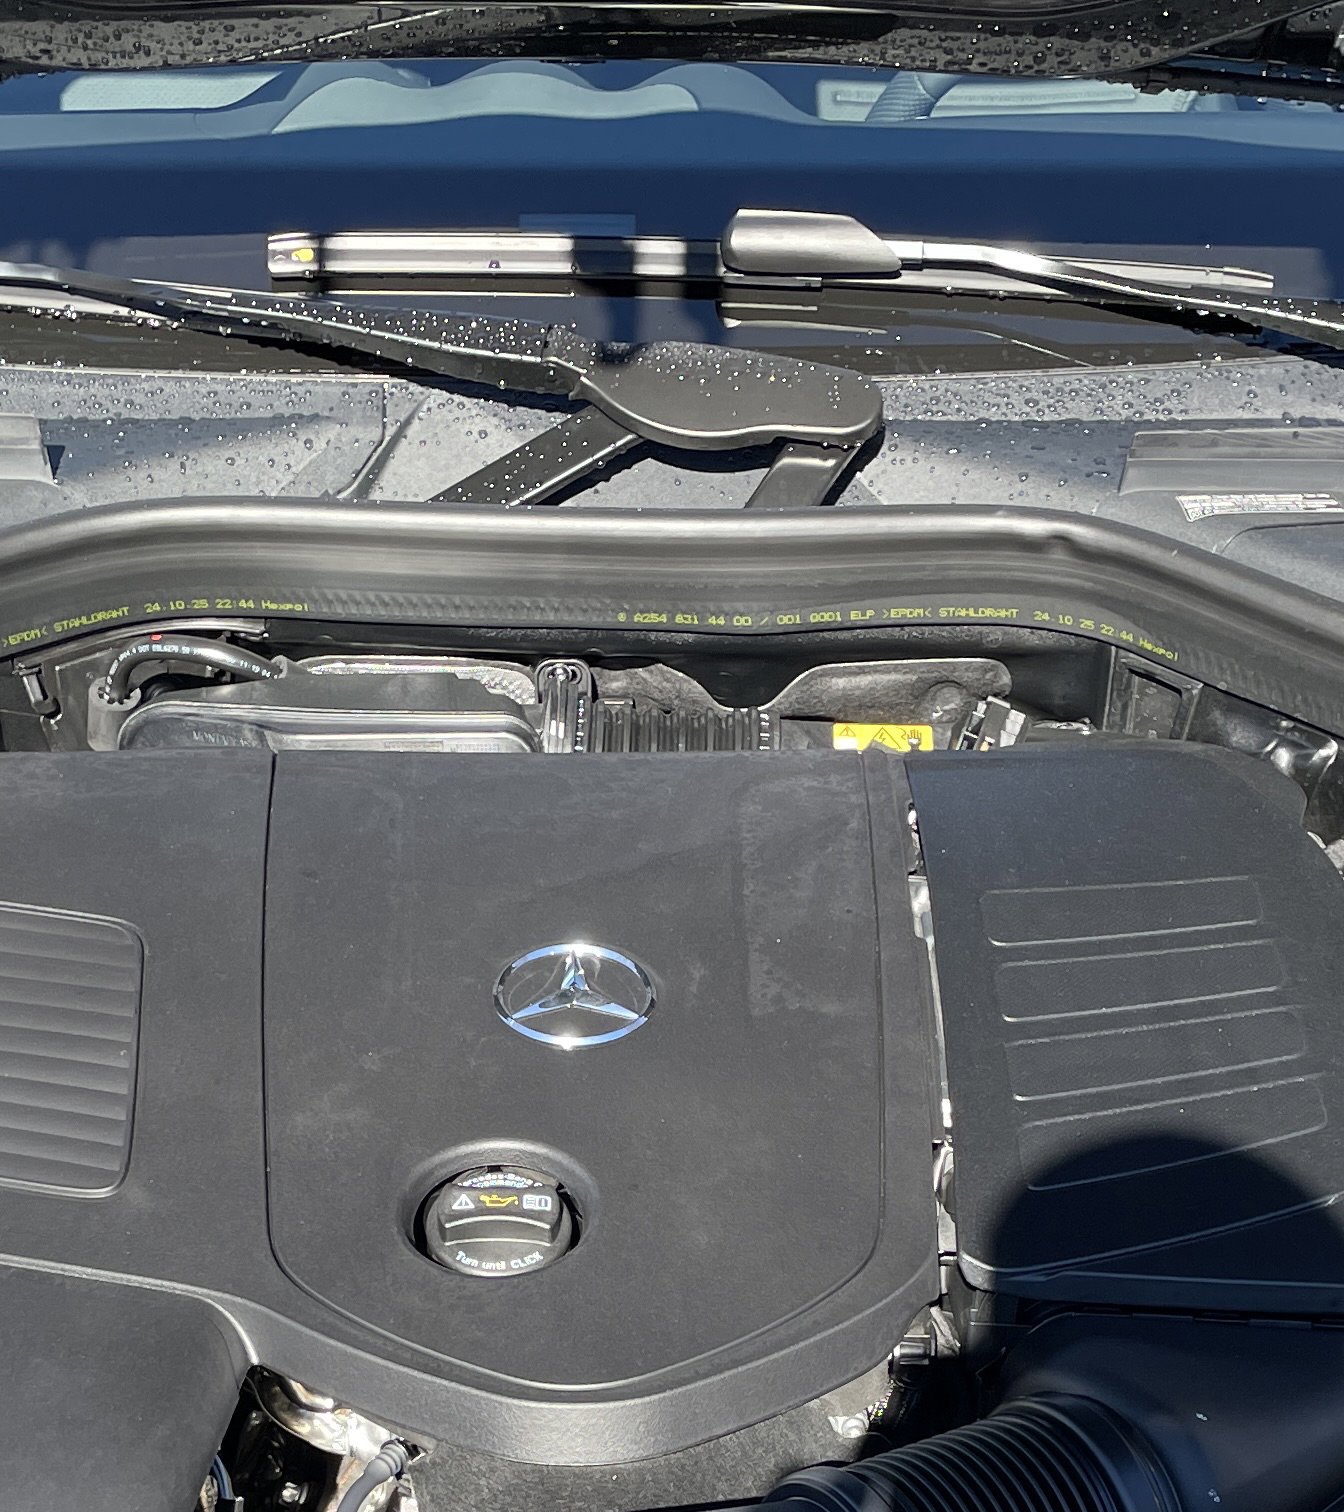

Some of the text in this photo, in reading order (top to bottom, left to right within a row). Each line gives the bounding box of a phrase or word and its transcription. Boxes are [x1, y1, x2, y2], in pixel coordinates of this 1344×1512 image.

[850, 610, 875, 620] ELP
[455, 1251, 544, 1271] Turn until CLICK
